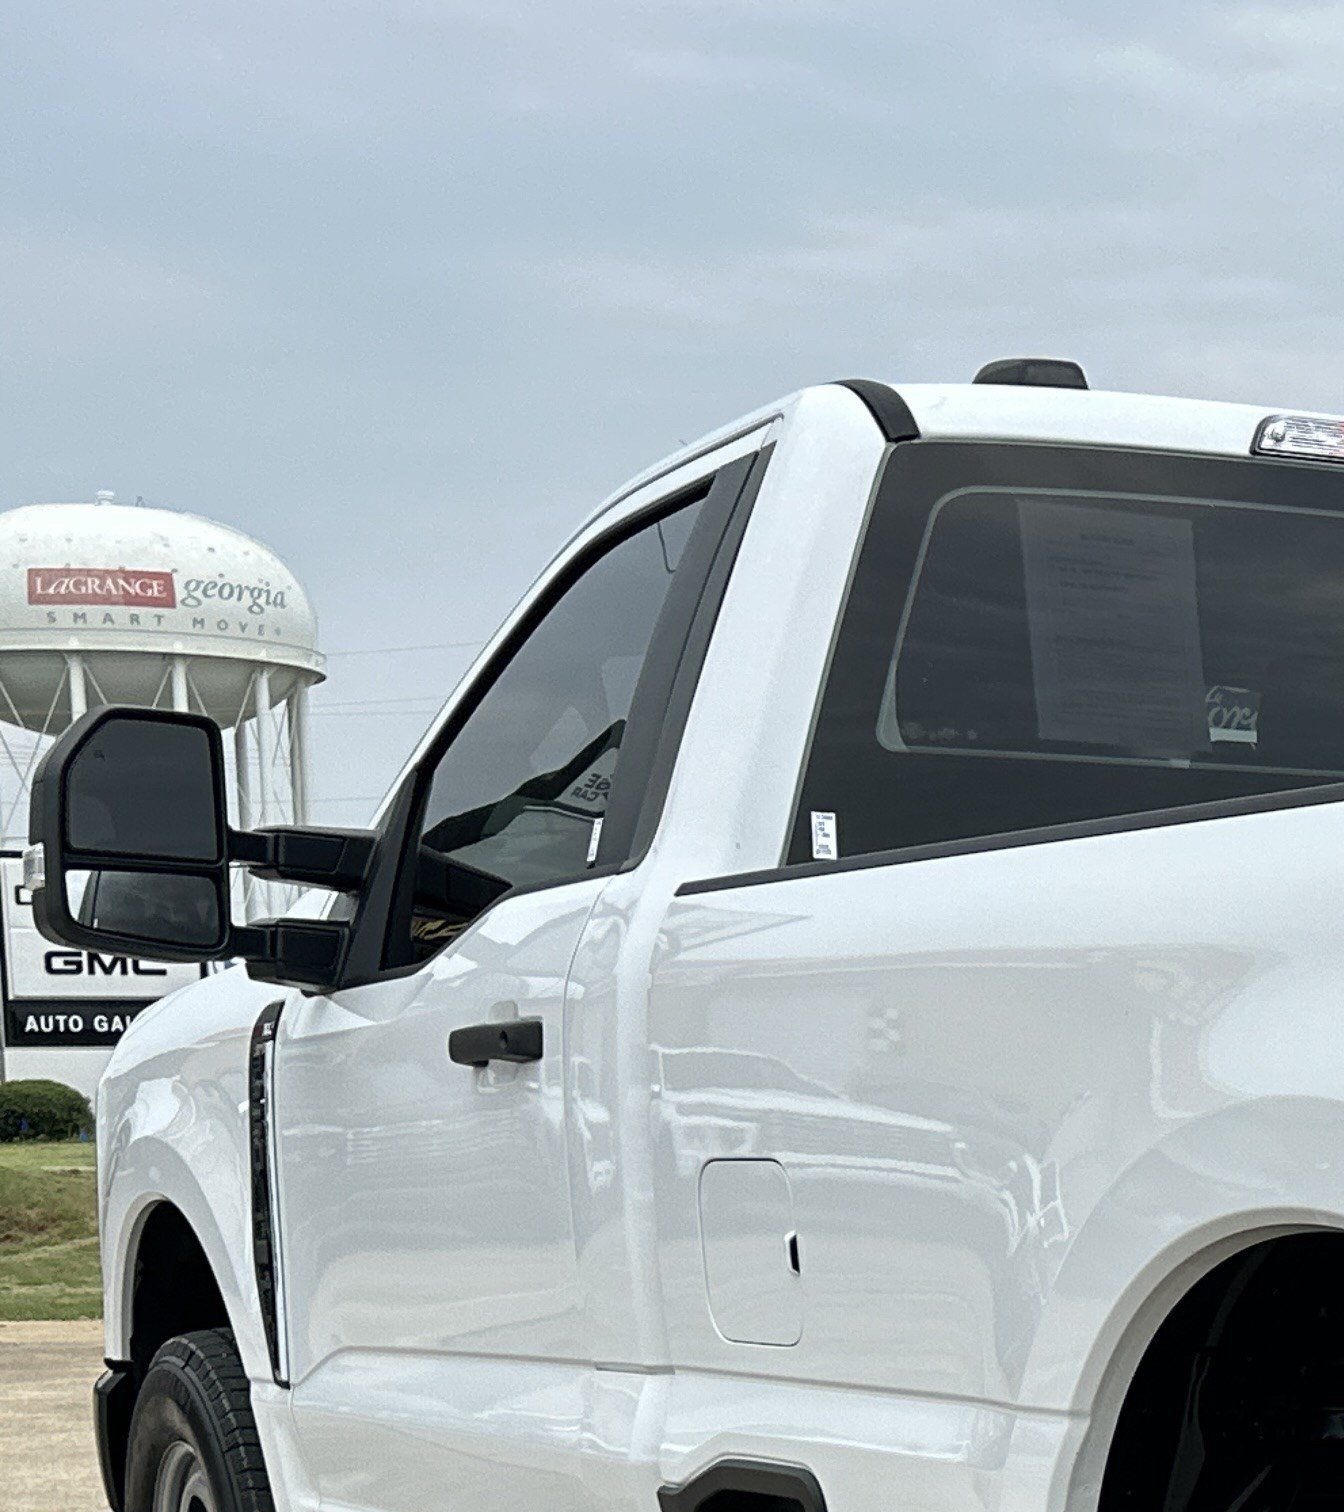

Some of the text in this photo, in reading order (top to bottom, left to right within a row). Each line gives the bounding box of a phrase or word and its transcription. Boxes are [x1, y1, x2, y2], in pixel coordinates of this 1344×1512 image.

[35, 576, 287, 615] LaGRANGE georgia
[46, 611, 164, 627] SMART
[24, 1014, 84, 1033] AUTO
